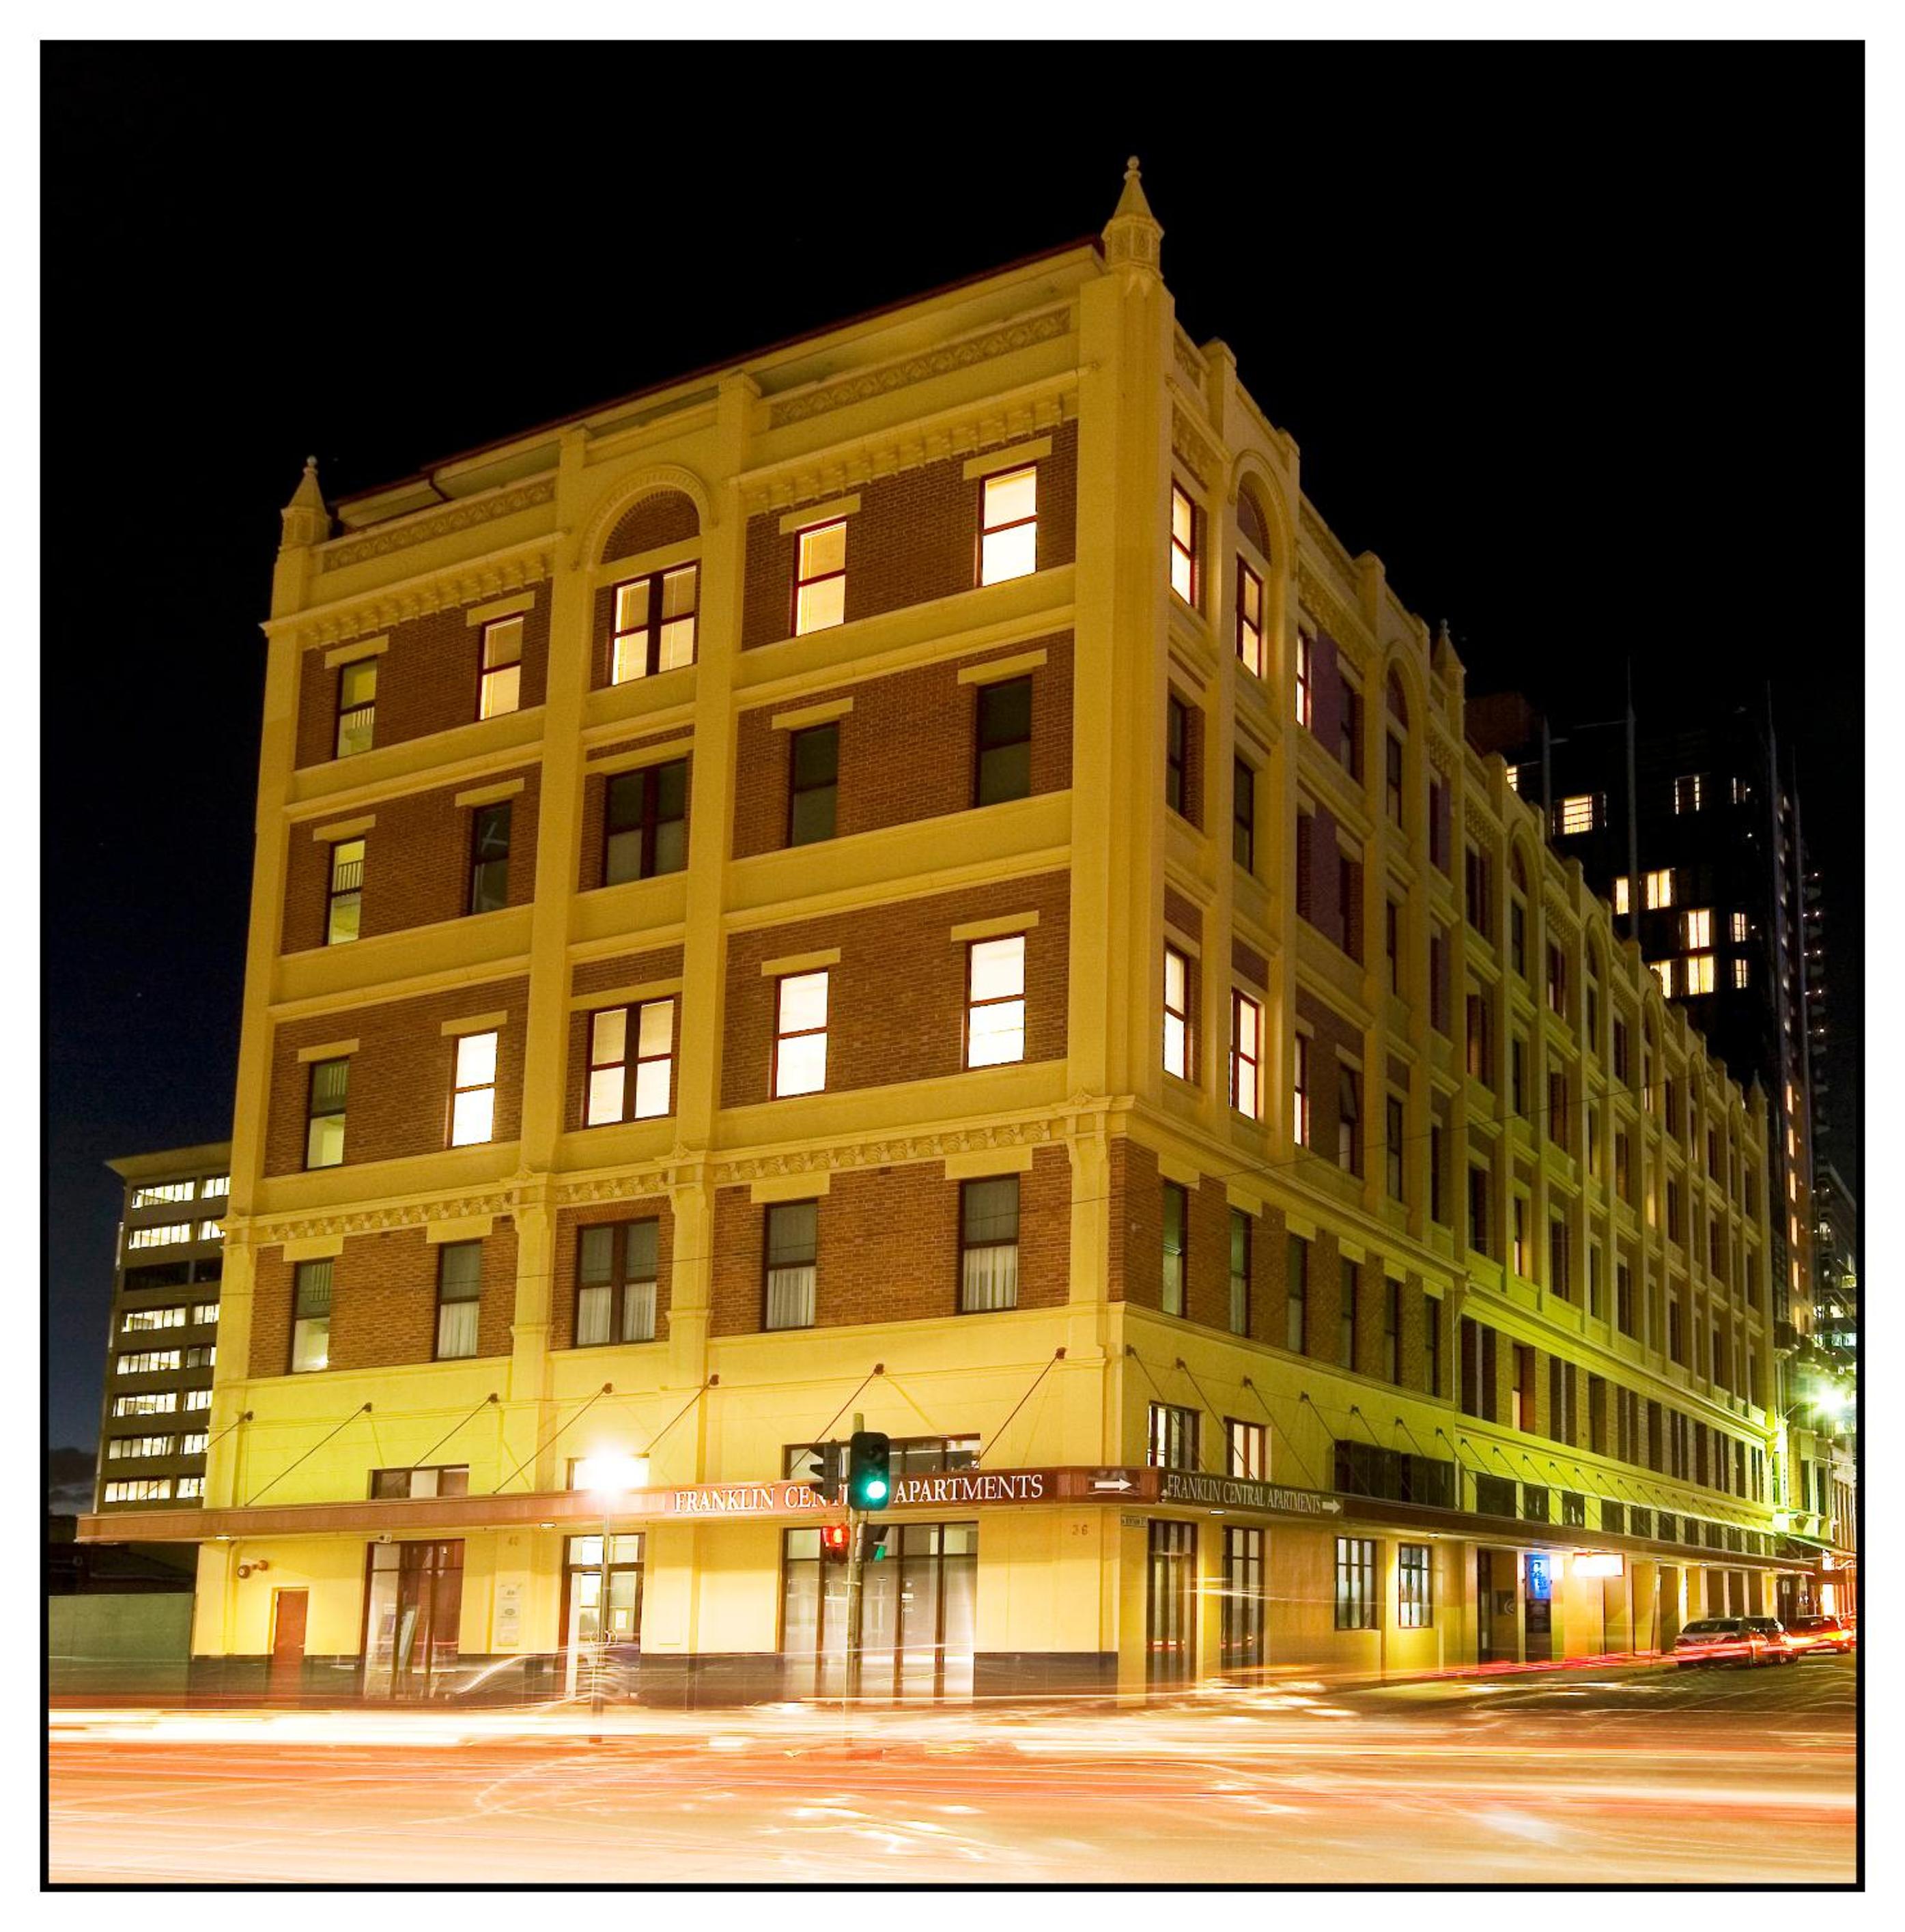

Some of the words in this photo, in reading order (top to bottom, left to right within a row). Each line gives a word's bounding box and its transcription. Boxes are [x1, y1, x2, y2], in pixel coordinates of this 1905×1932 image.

[675, 1487, 774, 1514] FRANKLIN
[894, 1474, 1043, 1503] APARTMENTS
[1168, 1474, 1221, 1502] FRANKLIN
[1223, 1481, 1265, 1507] CENTRAL
[1267, 1488, 1322, 1514] APARTMENTS
